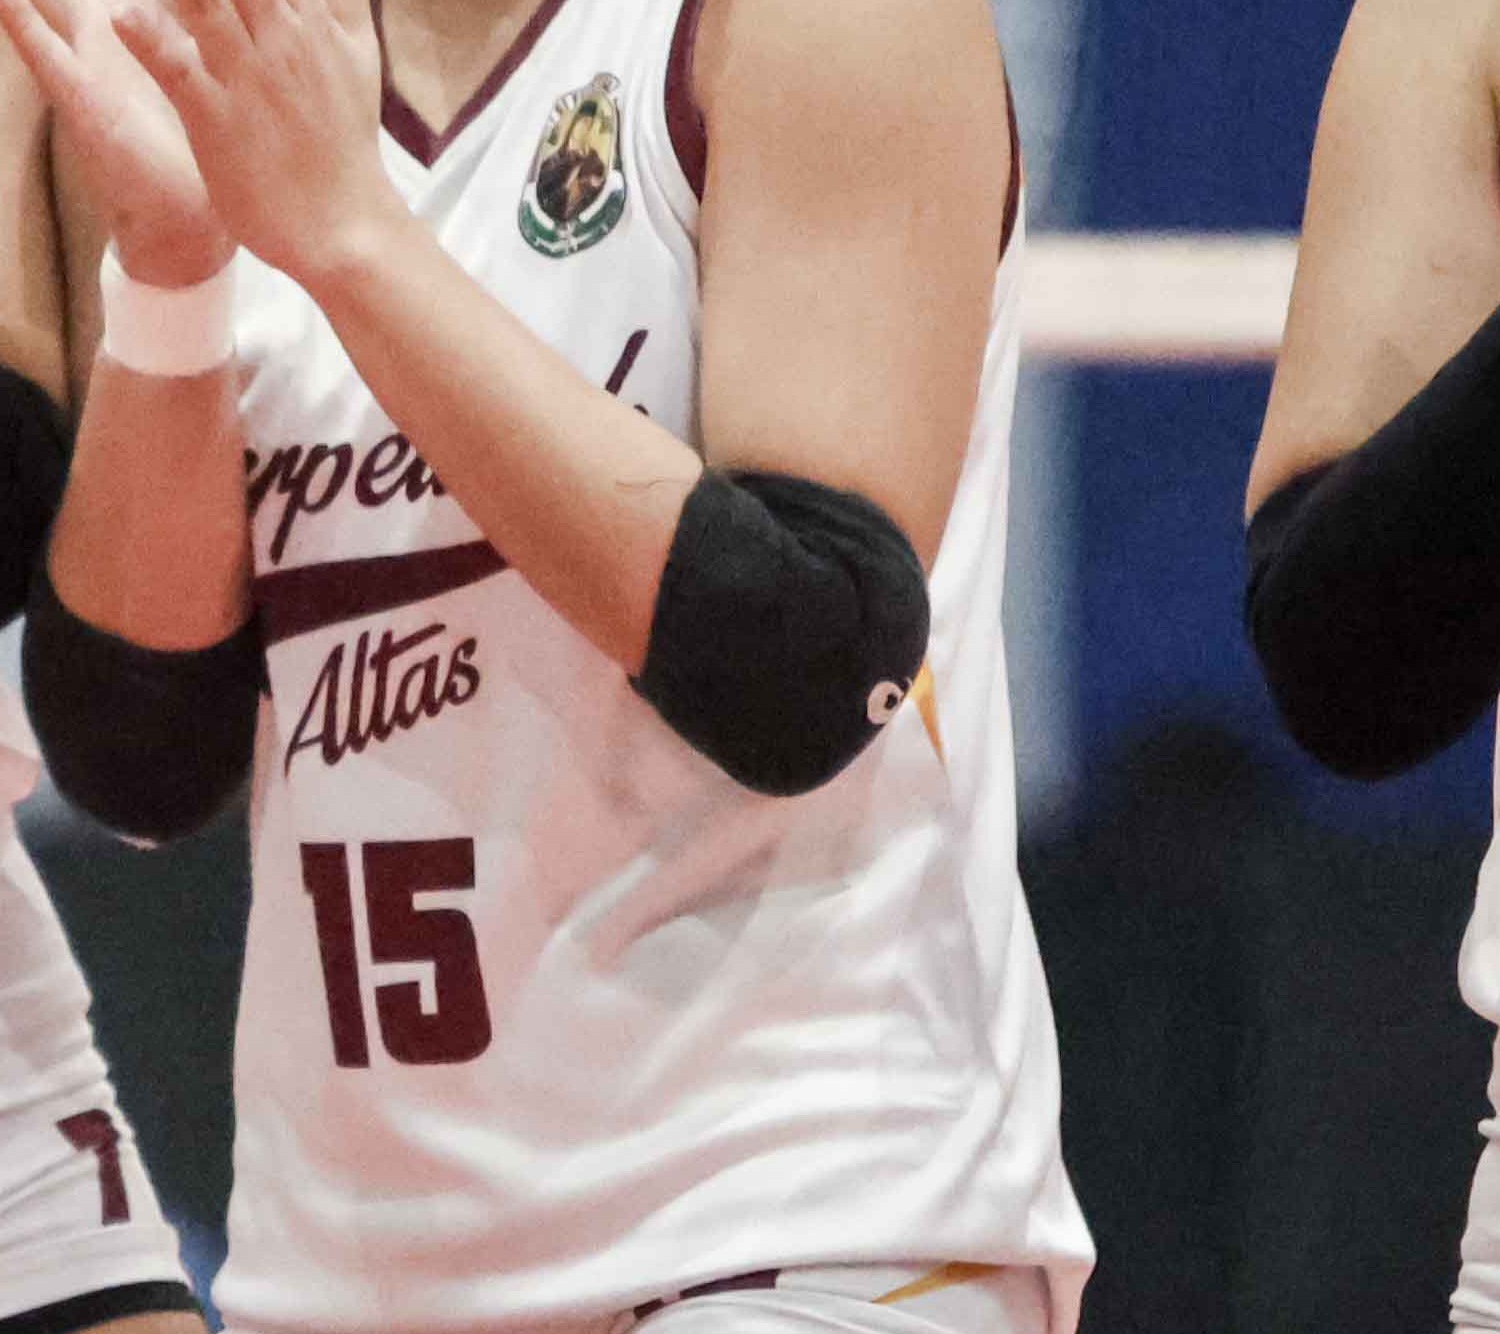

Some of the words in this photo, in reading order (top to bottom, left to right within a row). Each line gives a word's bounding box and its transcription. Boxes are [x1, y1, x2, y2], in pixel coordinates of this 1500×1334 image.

[284, 623, 481, 778] Altas
[300, 837, 492, 1068] 15
[55, 1108, 131, 1226] 7
